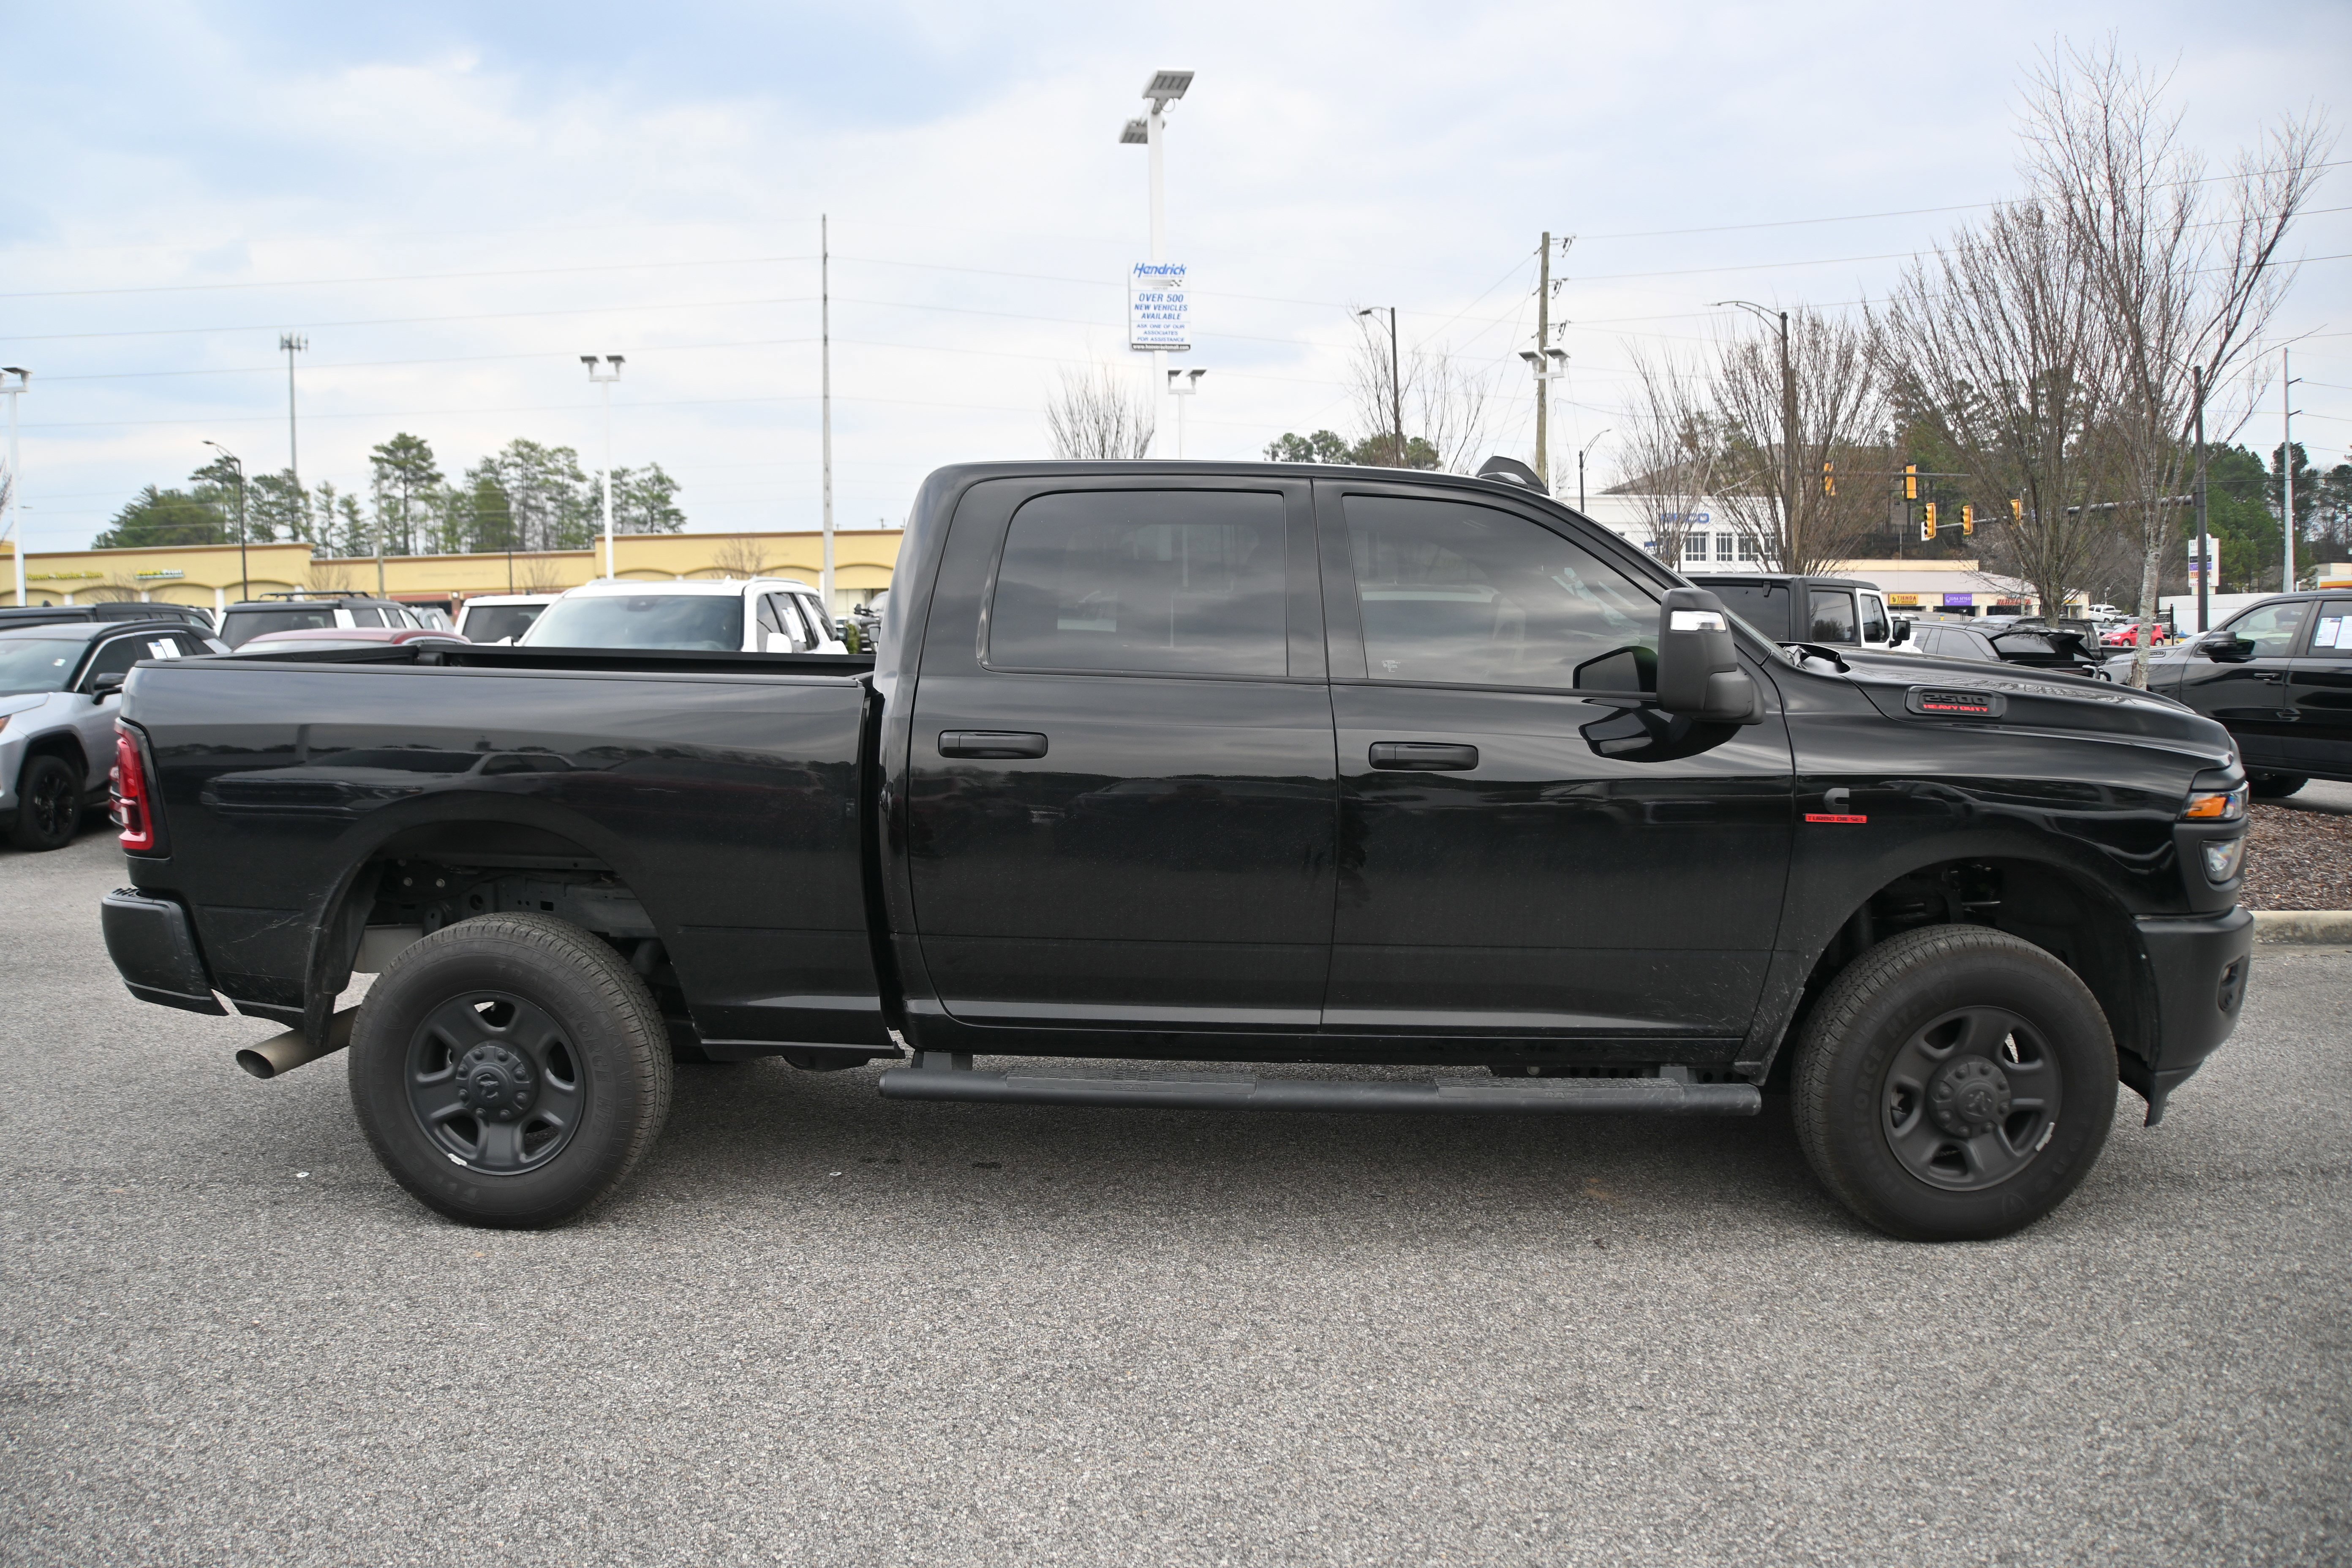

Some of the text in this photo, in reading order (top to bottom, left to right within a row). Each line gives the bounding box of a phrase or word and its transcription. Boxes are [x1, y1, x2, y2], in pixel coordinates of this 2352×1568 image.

[1133, 263, 1186, 278] Hendrick
[1139, 293, 1184, 302] OVER 500
[1922, 694, 1987, 706] 2500
[495, 962, 612, 1083] TRANSFORCE
[1851, 1044, 1903, 1196] TRANSFORCE
